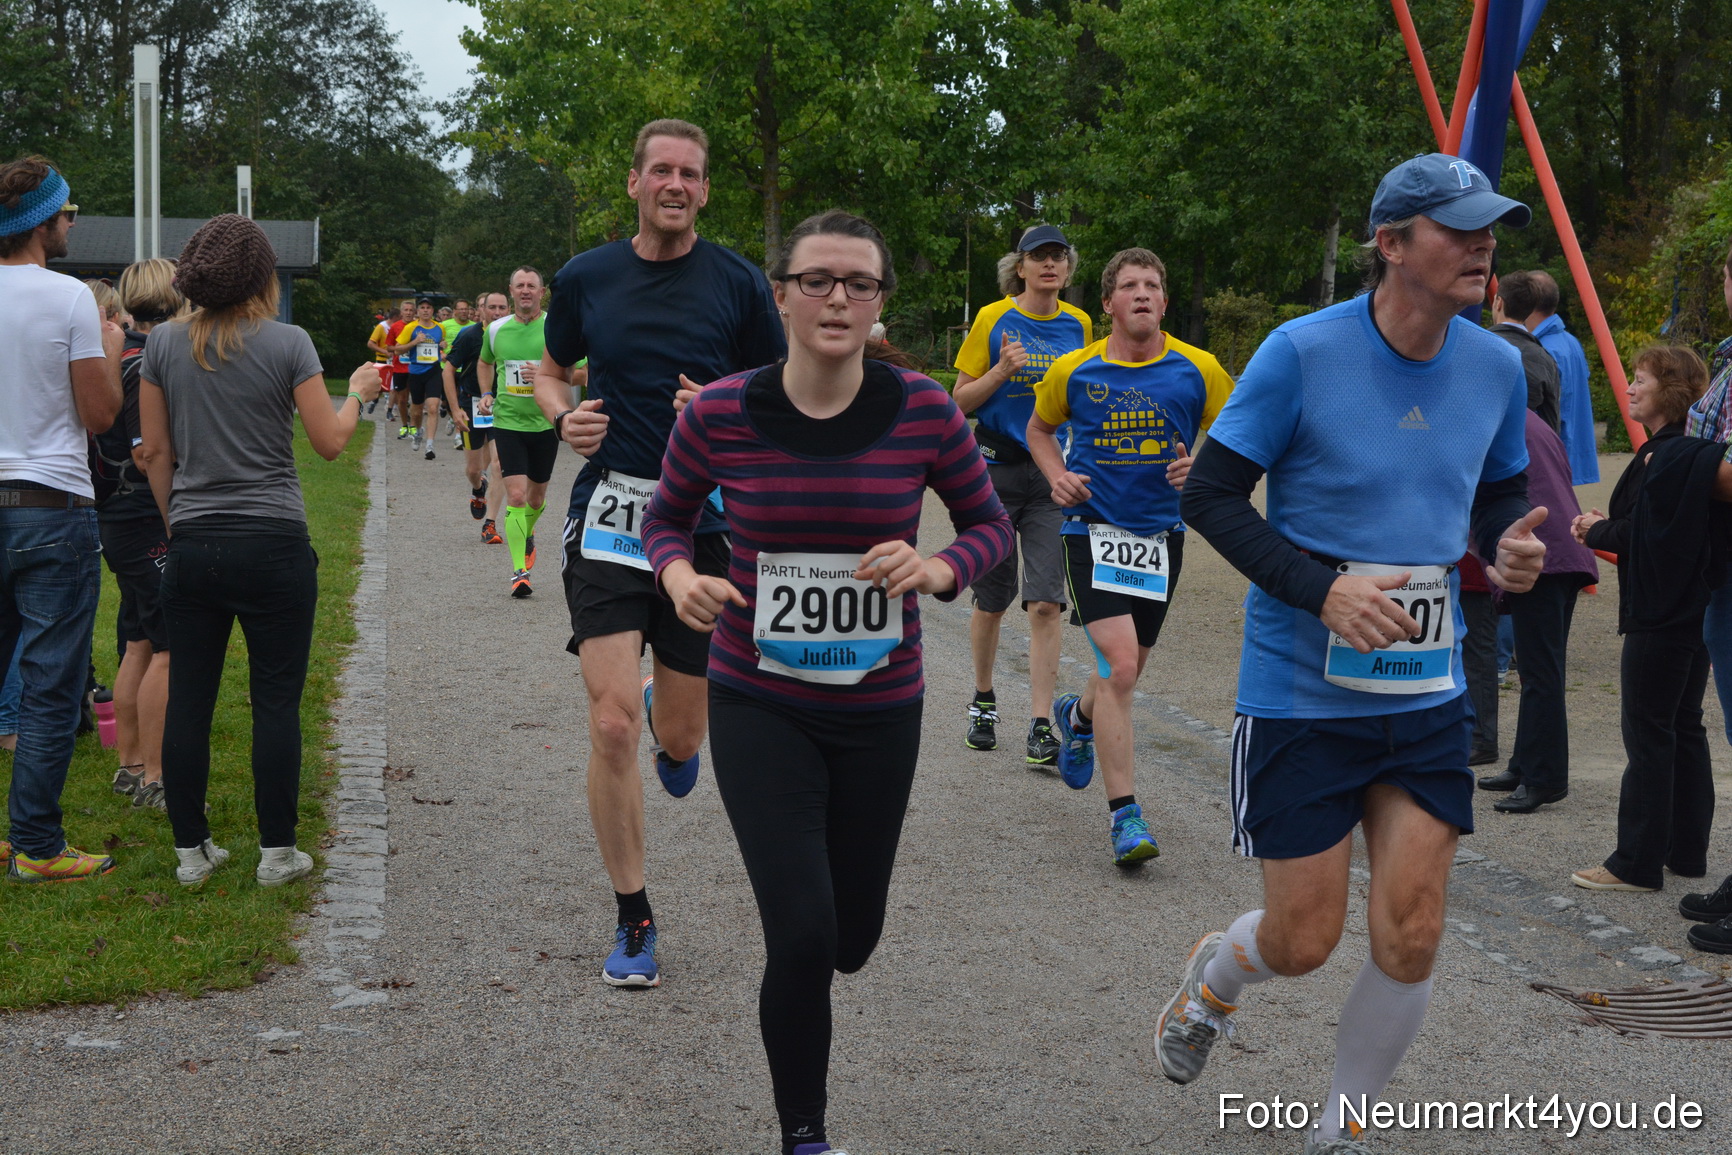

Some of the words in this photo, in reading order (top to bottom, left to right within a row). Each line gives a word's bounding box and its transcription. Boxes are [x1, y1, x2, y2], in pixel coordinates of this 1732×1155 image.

[601, 480, 627, 494] PARTL
[1091, 530, 1118, 539] PARTL
[1100, 540, 1162, 572] 2024
[761, 564, 806, 579] PARTL
[1114, 571, 1145, 587] Stefan
[1397, 579, 1442, 591] eumarkt
[769, 585, 889, 635] 2900
[799, 647, 856, 666] Judith
[1371, 657, 1423, 675] Armin
